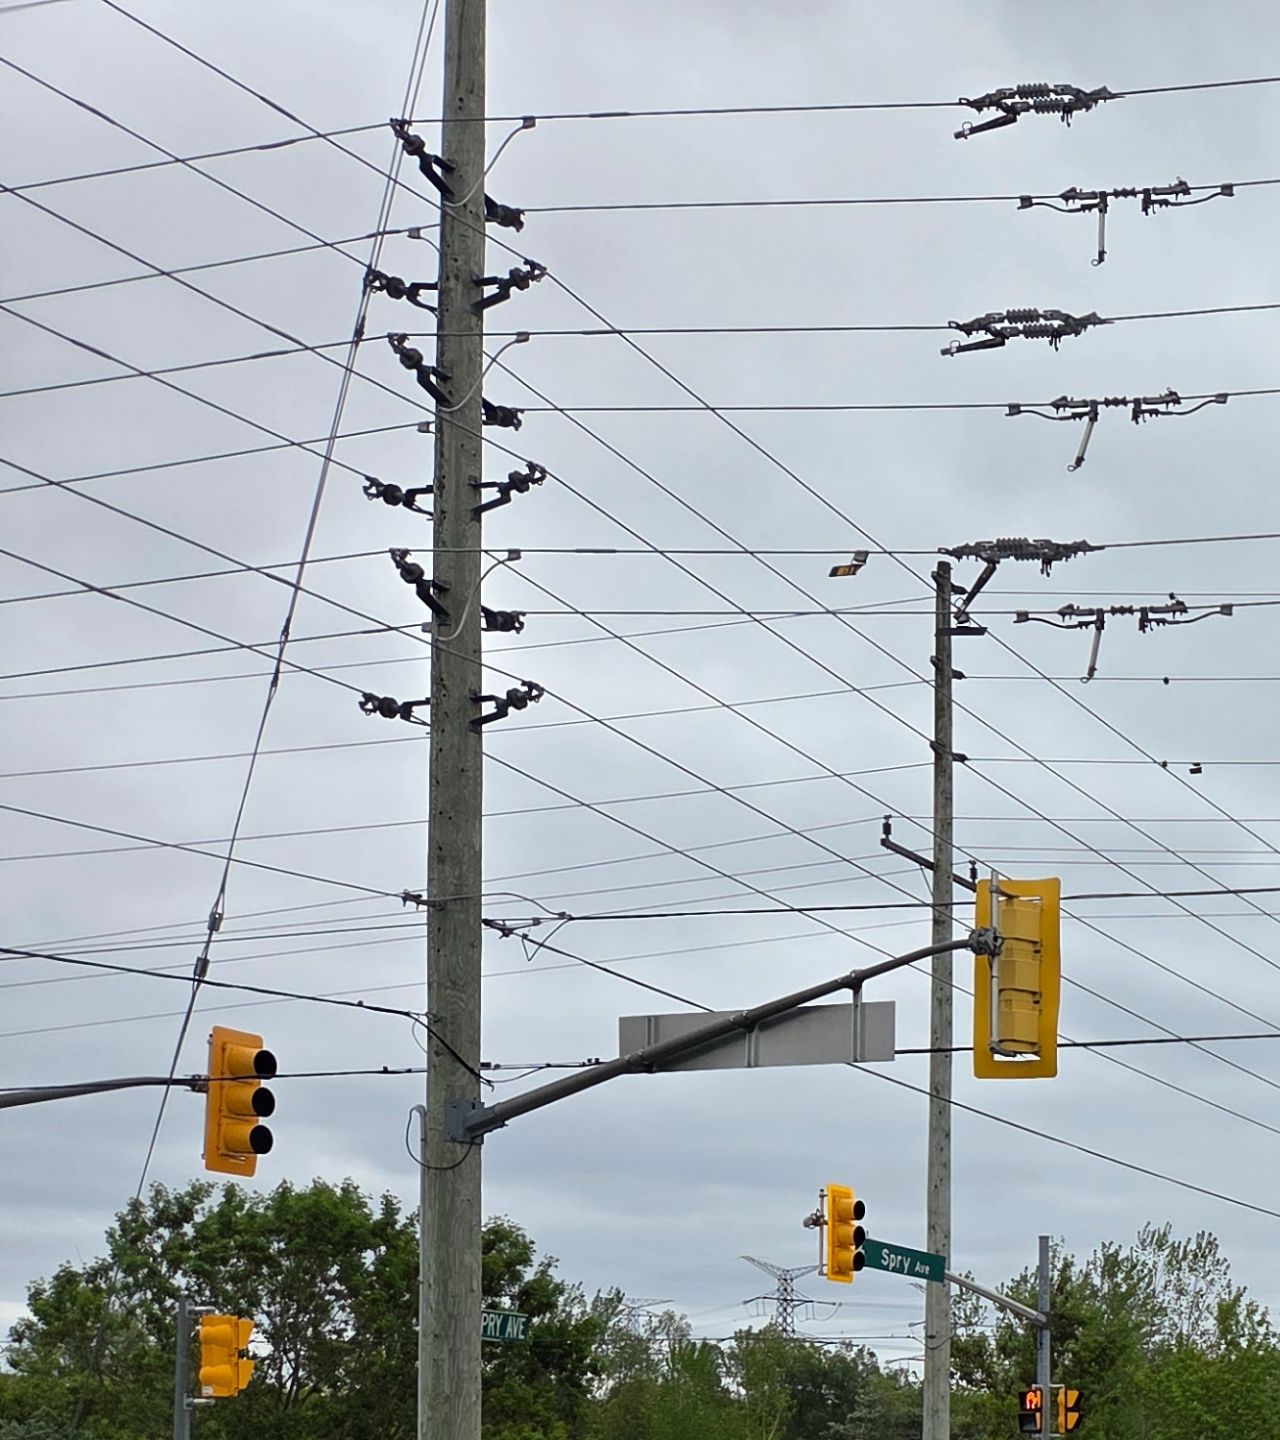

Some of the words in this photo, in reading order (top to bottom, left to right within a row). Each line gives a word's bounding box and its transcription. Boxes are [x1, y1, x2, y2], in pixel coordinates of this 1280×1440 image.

[881, 1248, 911, 1275] Spry
[914, 1261, 930, 1275] Ave
[480, 1313, 503, 1337] PRY
[504, 1316, 526, 1339] AVE
